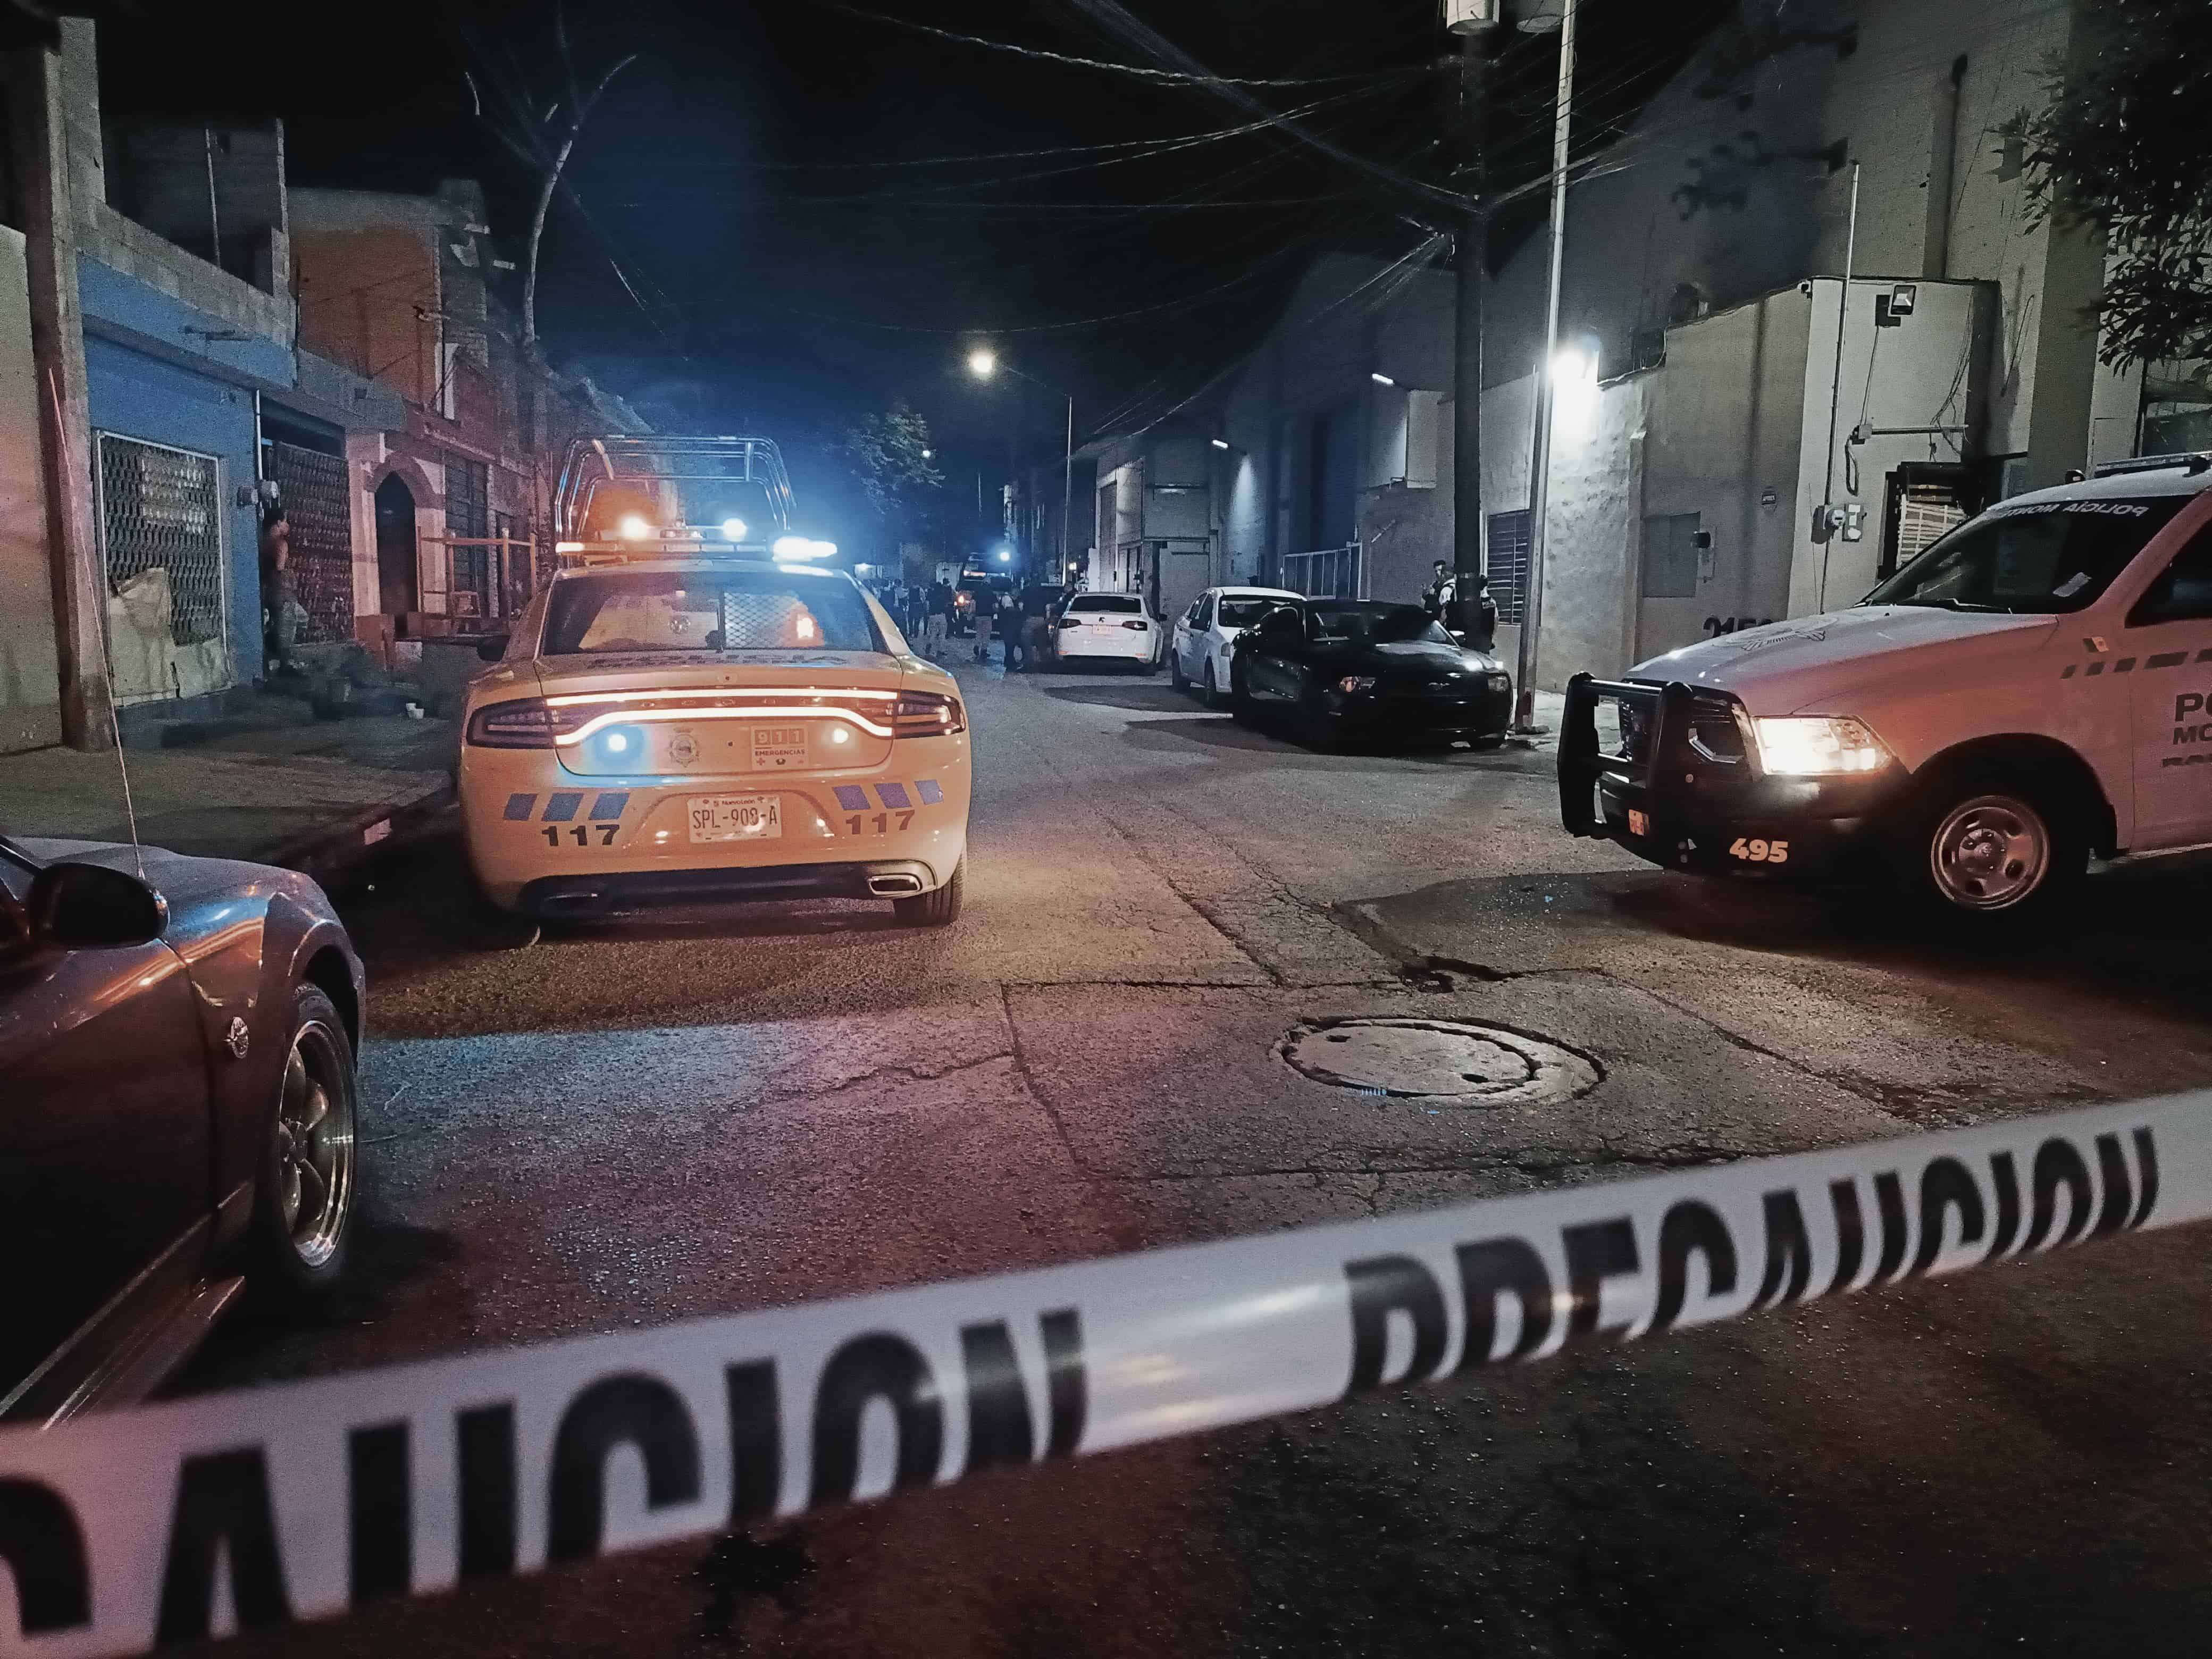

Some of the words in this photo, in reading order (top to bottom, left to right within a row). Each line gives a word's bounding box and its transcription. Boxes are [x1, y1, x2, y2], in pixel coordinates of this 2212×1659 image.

[2175, 693, 2212, 722] P
[845, 809, 915, 835] 117
[541, 824, 620, 847] 117
[1729, 838, 1788, 863] 495
